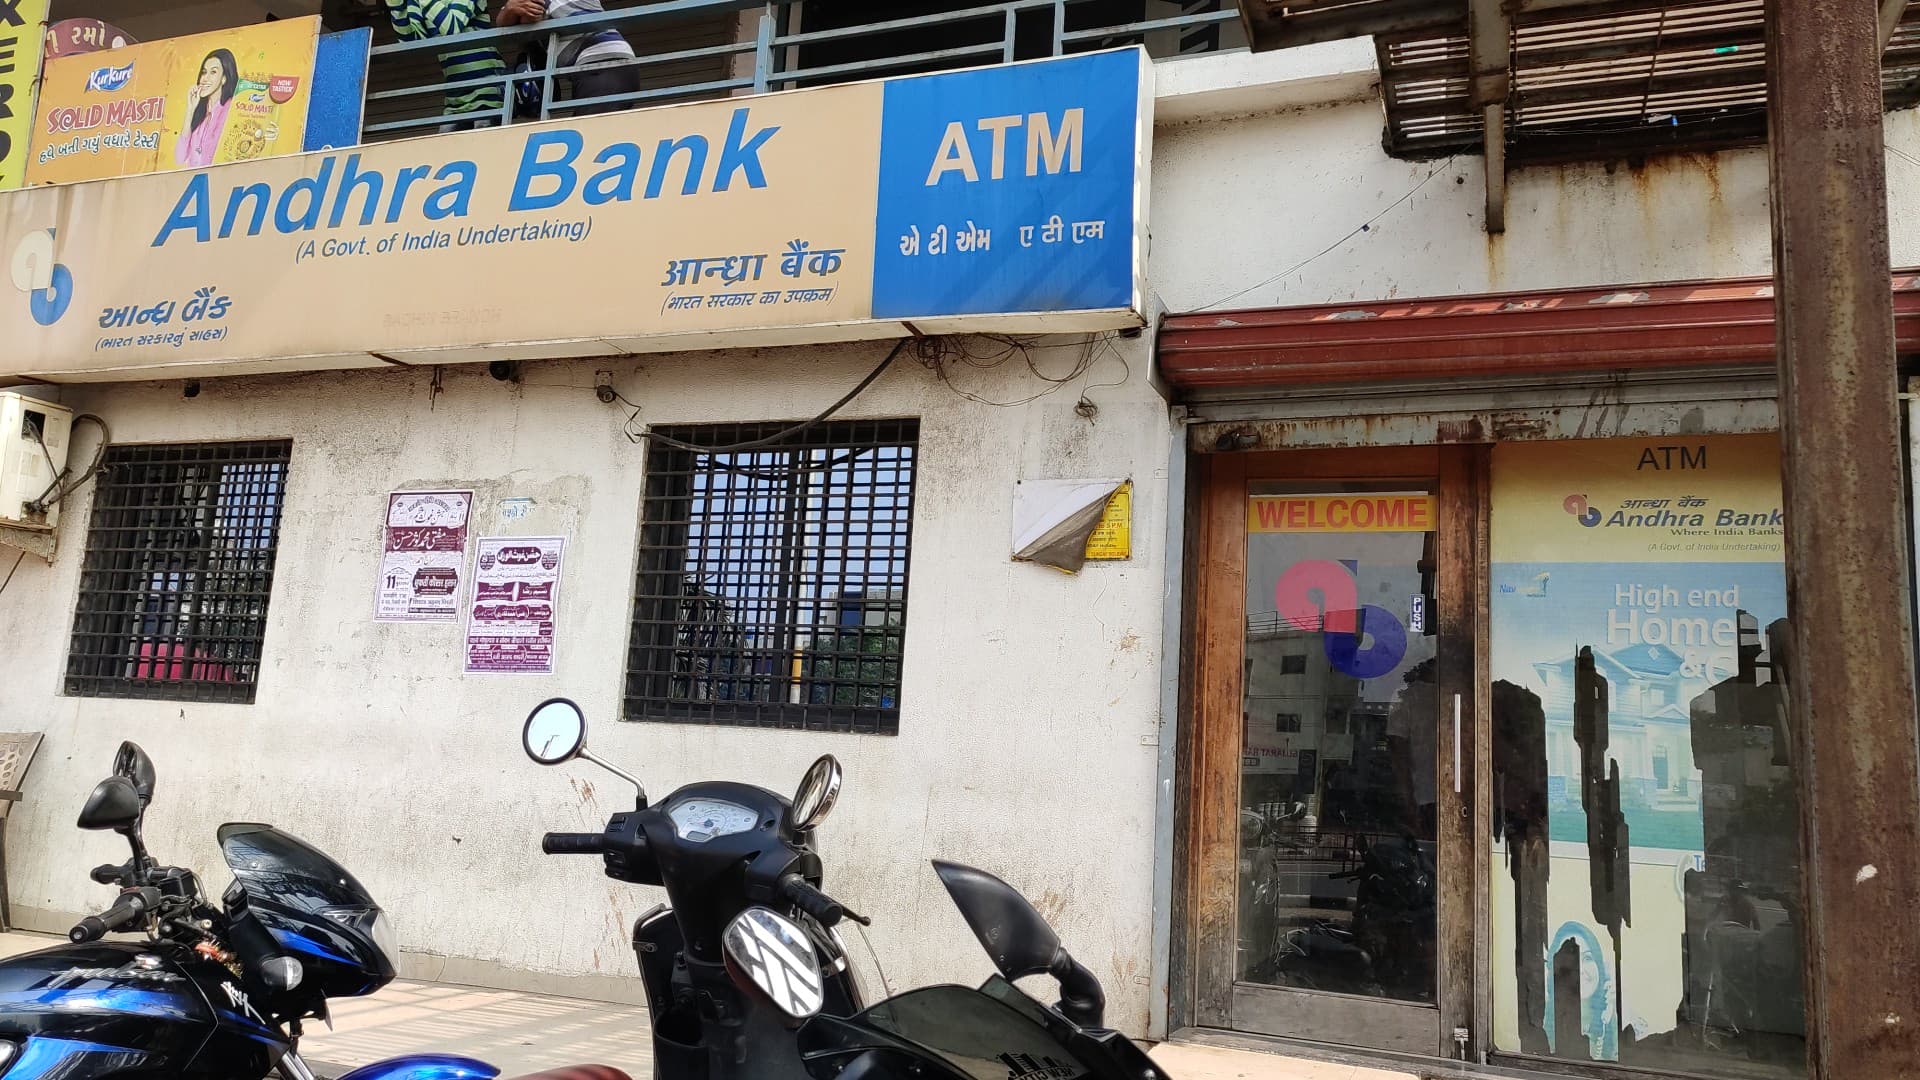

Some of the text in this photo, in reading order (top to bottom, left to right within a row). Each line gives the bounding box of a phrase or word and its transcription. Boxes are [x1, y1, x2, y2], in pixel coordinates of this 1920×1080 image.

[89, 66, 133, 91] Kurkure
[277, 79, 293, 87] NOW
[47, 96, 165, 134] SOLID MASTI
[235, 101, 255, 112] SOLID
[39, 129, 159, 164] હવે બની ગયું વધારે ટેસ્ટી
[924, 107, 1084, 186] ATM
[150, 107, 782, 248] Andhra Bank
[295, 216, 593, 264] (A Govt. of India Undertaking)
[899, 220, 991, 256] એ ટી એમ
[1019, 214, 1106, 248] ए टी एम
[661, 238, 846, 286] आन्ध्रा बैंक
[660, 291, 705, 316] (भारत
[707, 292, 757, 308] सरकार
[759, 290, 782, 305] का
[95, 326, 228, 351] (ભારત સરકારનું સાહસ)
[1636, 445, 1707, 471] ATM
[1256, 499, 1428, 530] WELCOME
[1678, 495, 1709, 509] बैंक
[1604, 508, 1784, 528] Andhra Bank
[1670, 528, 1784, 537] Where India Banks
[1697, 543, 1719, 551] India
[1720, 542, 1782, 553] Undertaking)
[1614, 583, 1740, 613] High end
[1413, 597, 1422, 630] PUSH
